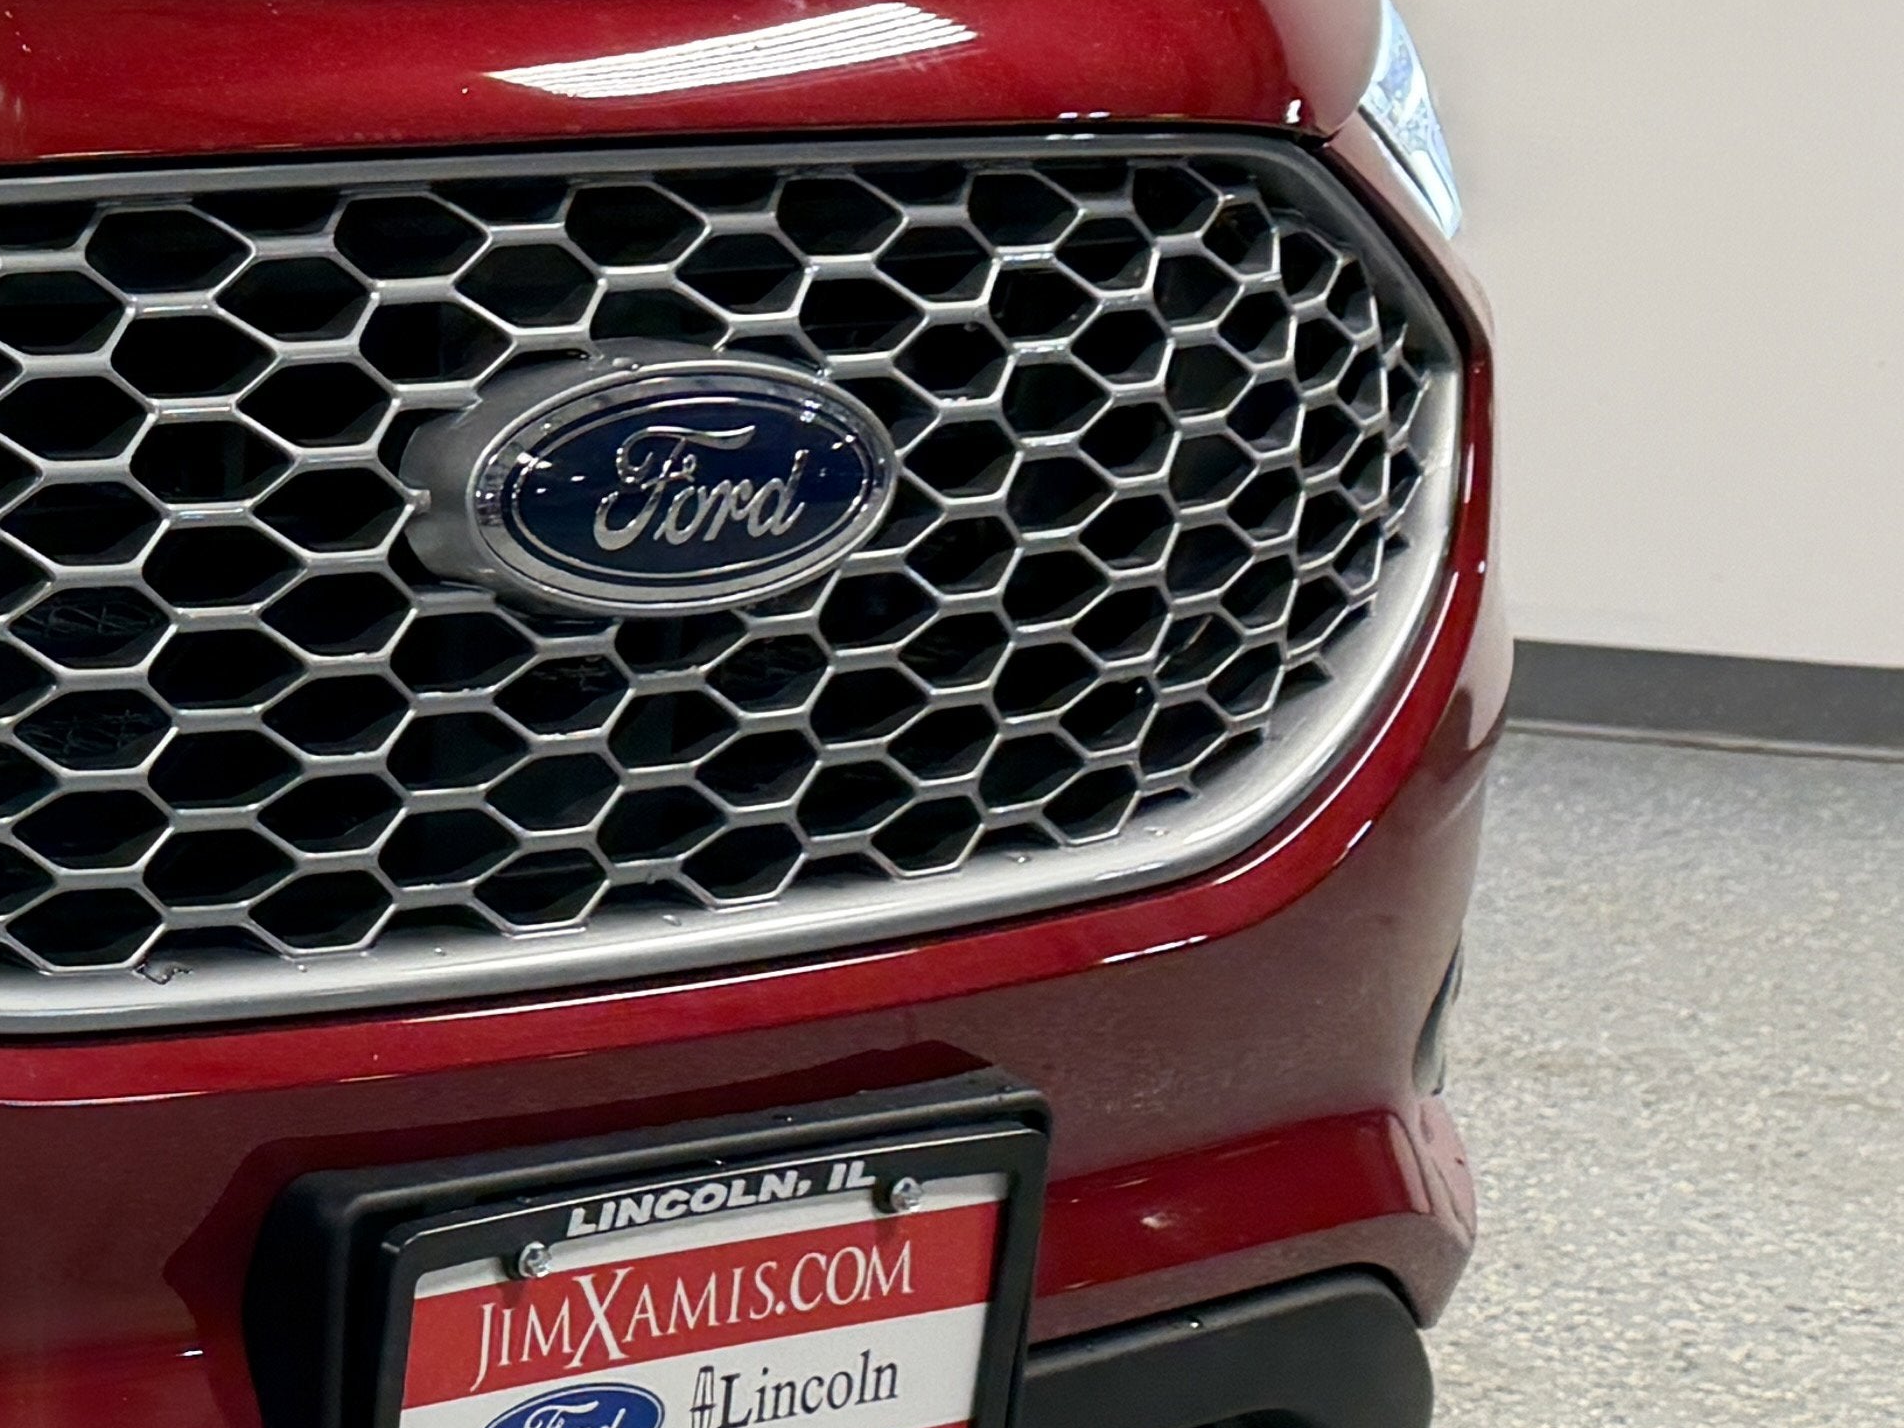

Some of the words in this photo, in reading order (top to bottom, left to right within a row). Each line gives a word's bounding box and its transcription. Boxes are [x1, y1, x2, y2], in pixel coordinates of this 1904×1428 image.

[592, 424, 810, 552] Ford
[565, 1169, 813, 1238] LINCOLN,
[827, 1160, 876, 1191] IL
